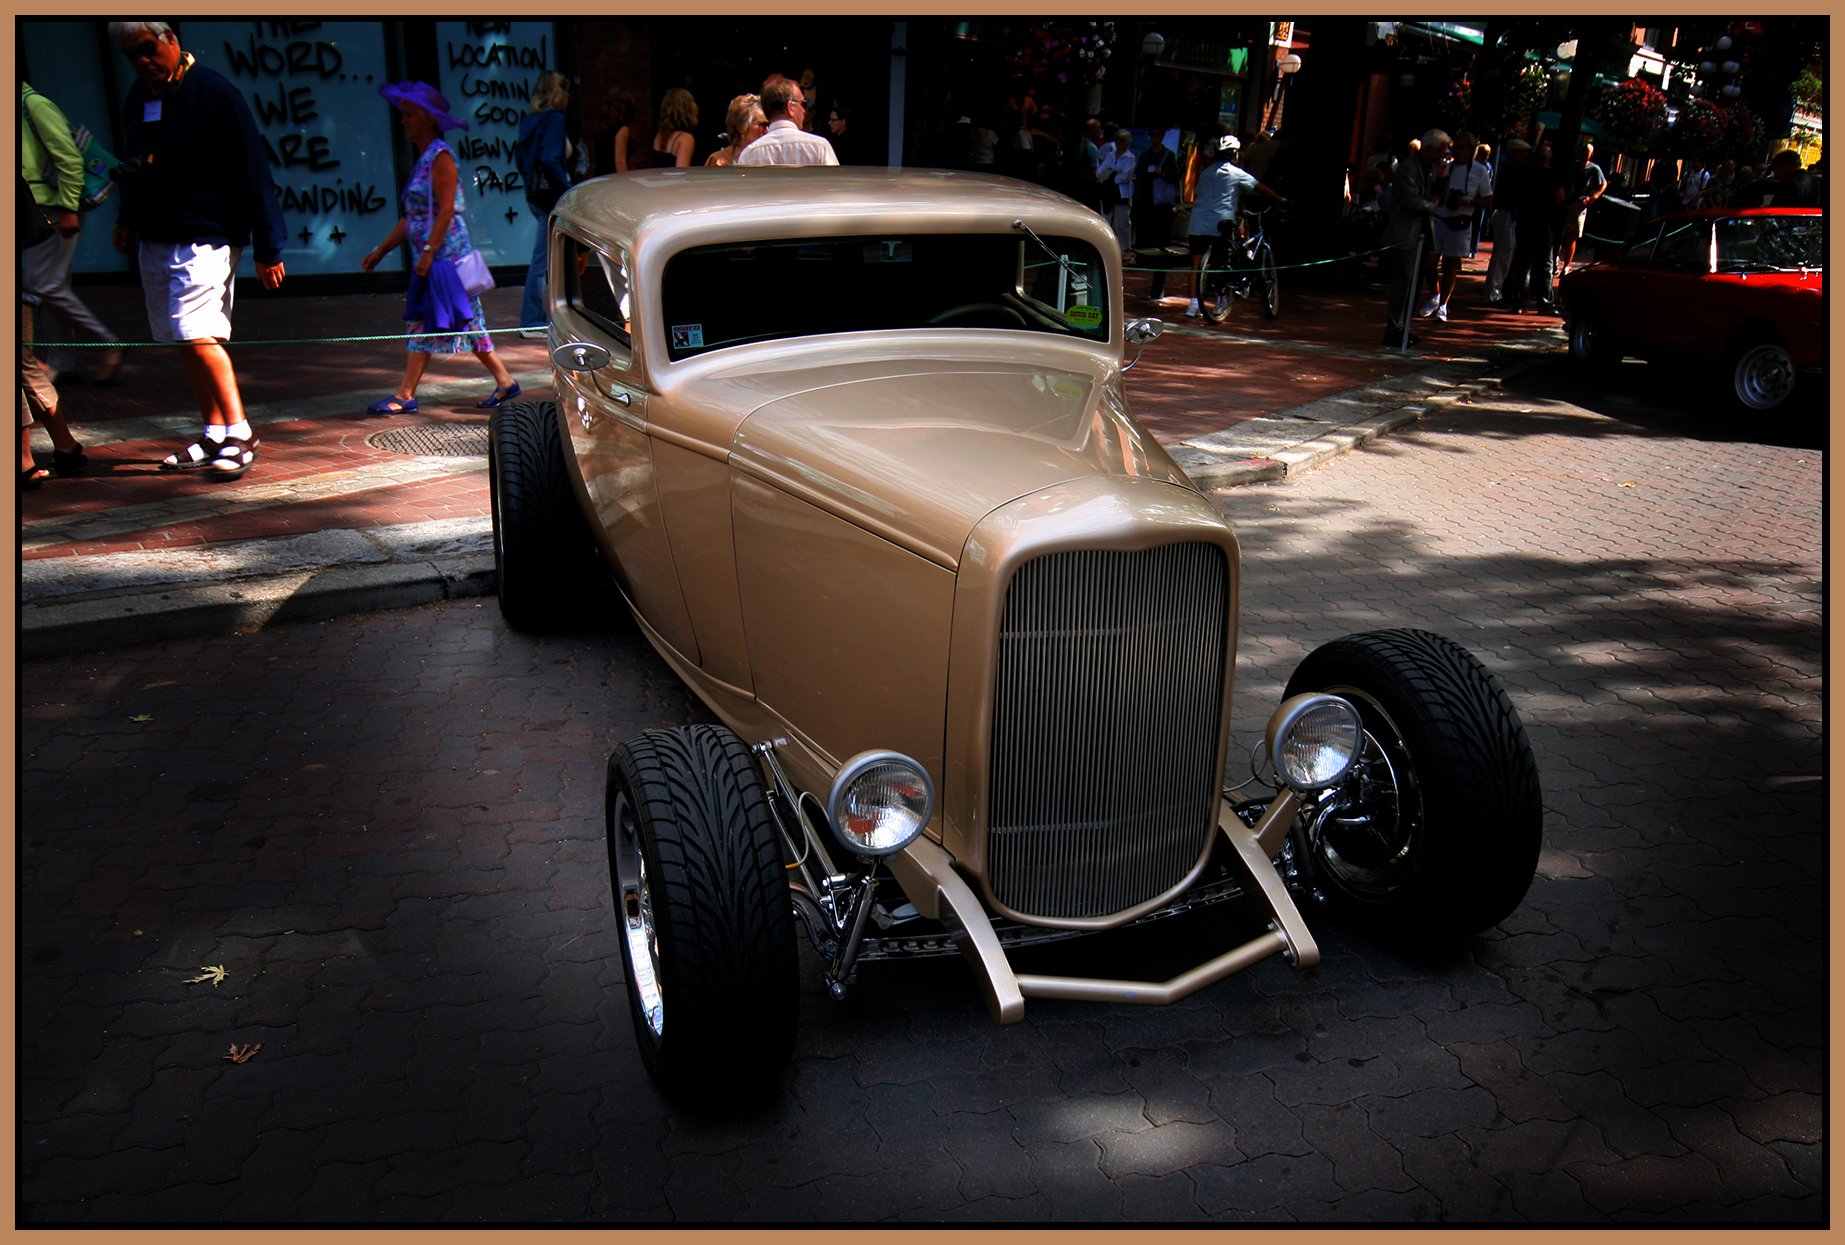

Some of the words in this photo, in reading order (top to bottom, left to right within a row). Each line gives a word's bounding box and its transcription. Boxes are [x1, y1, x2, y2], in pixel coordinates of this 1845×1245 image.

[448, 35, 547, 70] LOCATION
[461, 73, 530, 102] COMIN
[255, 82, 318, 126] WE
[475, 102, 527, 126] SOO
